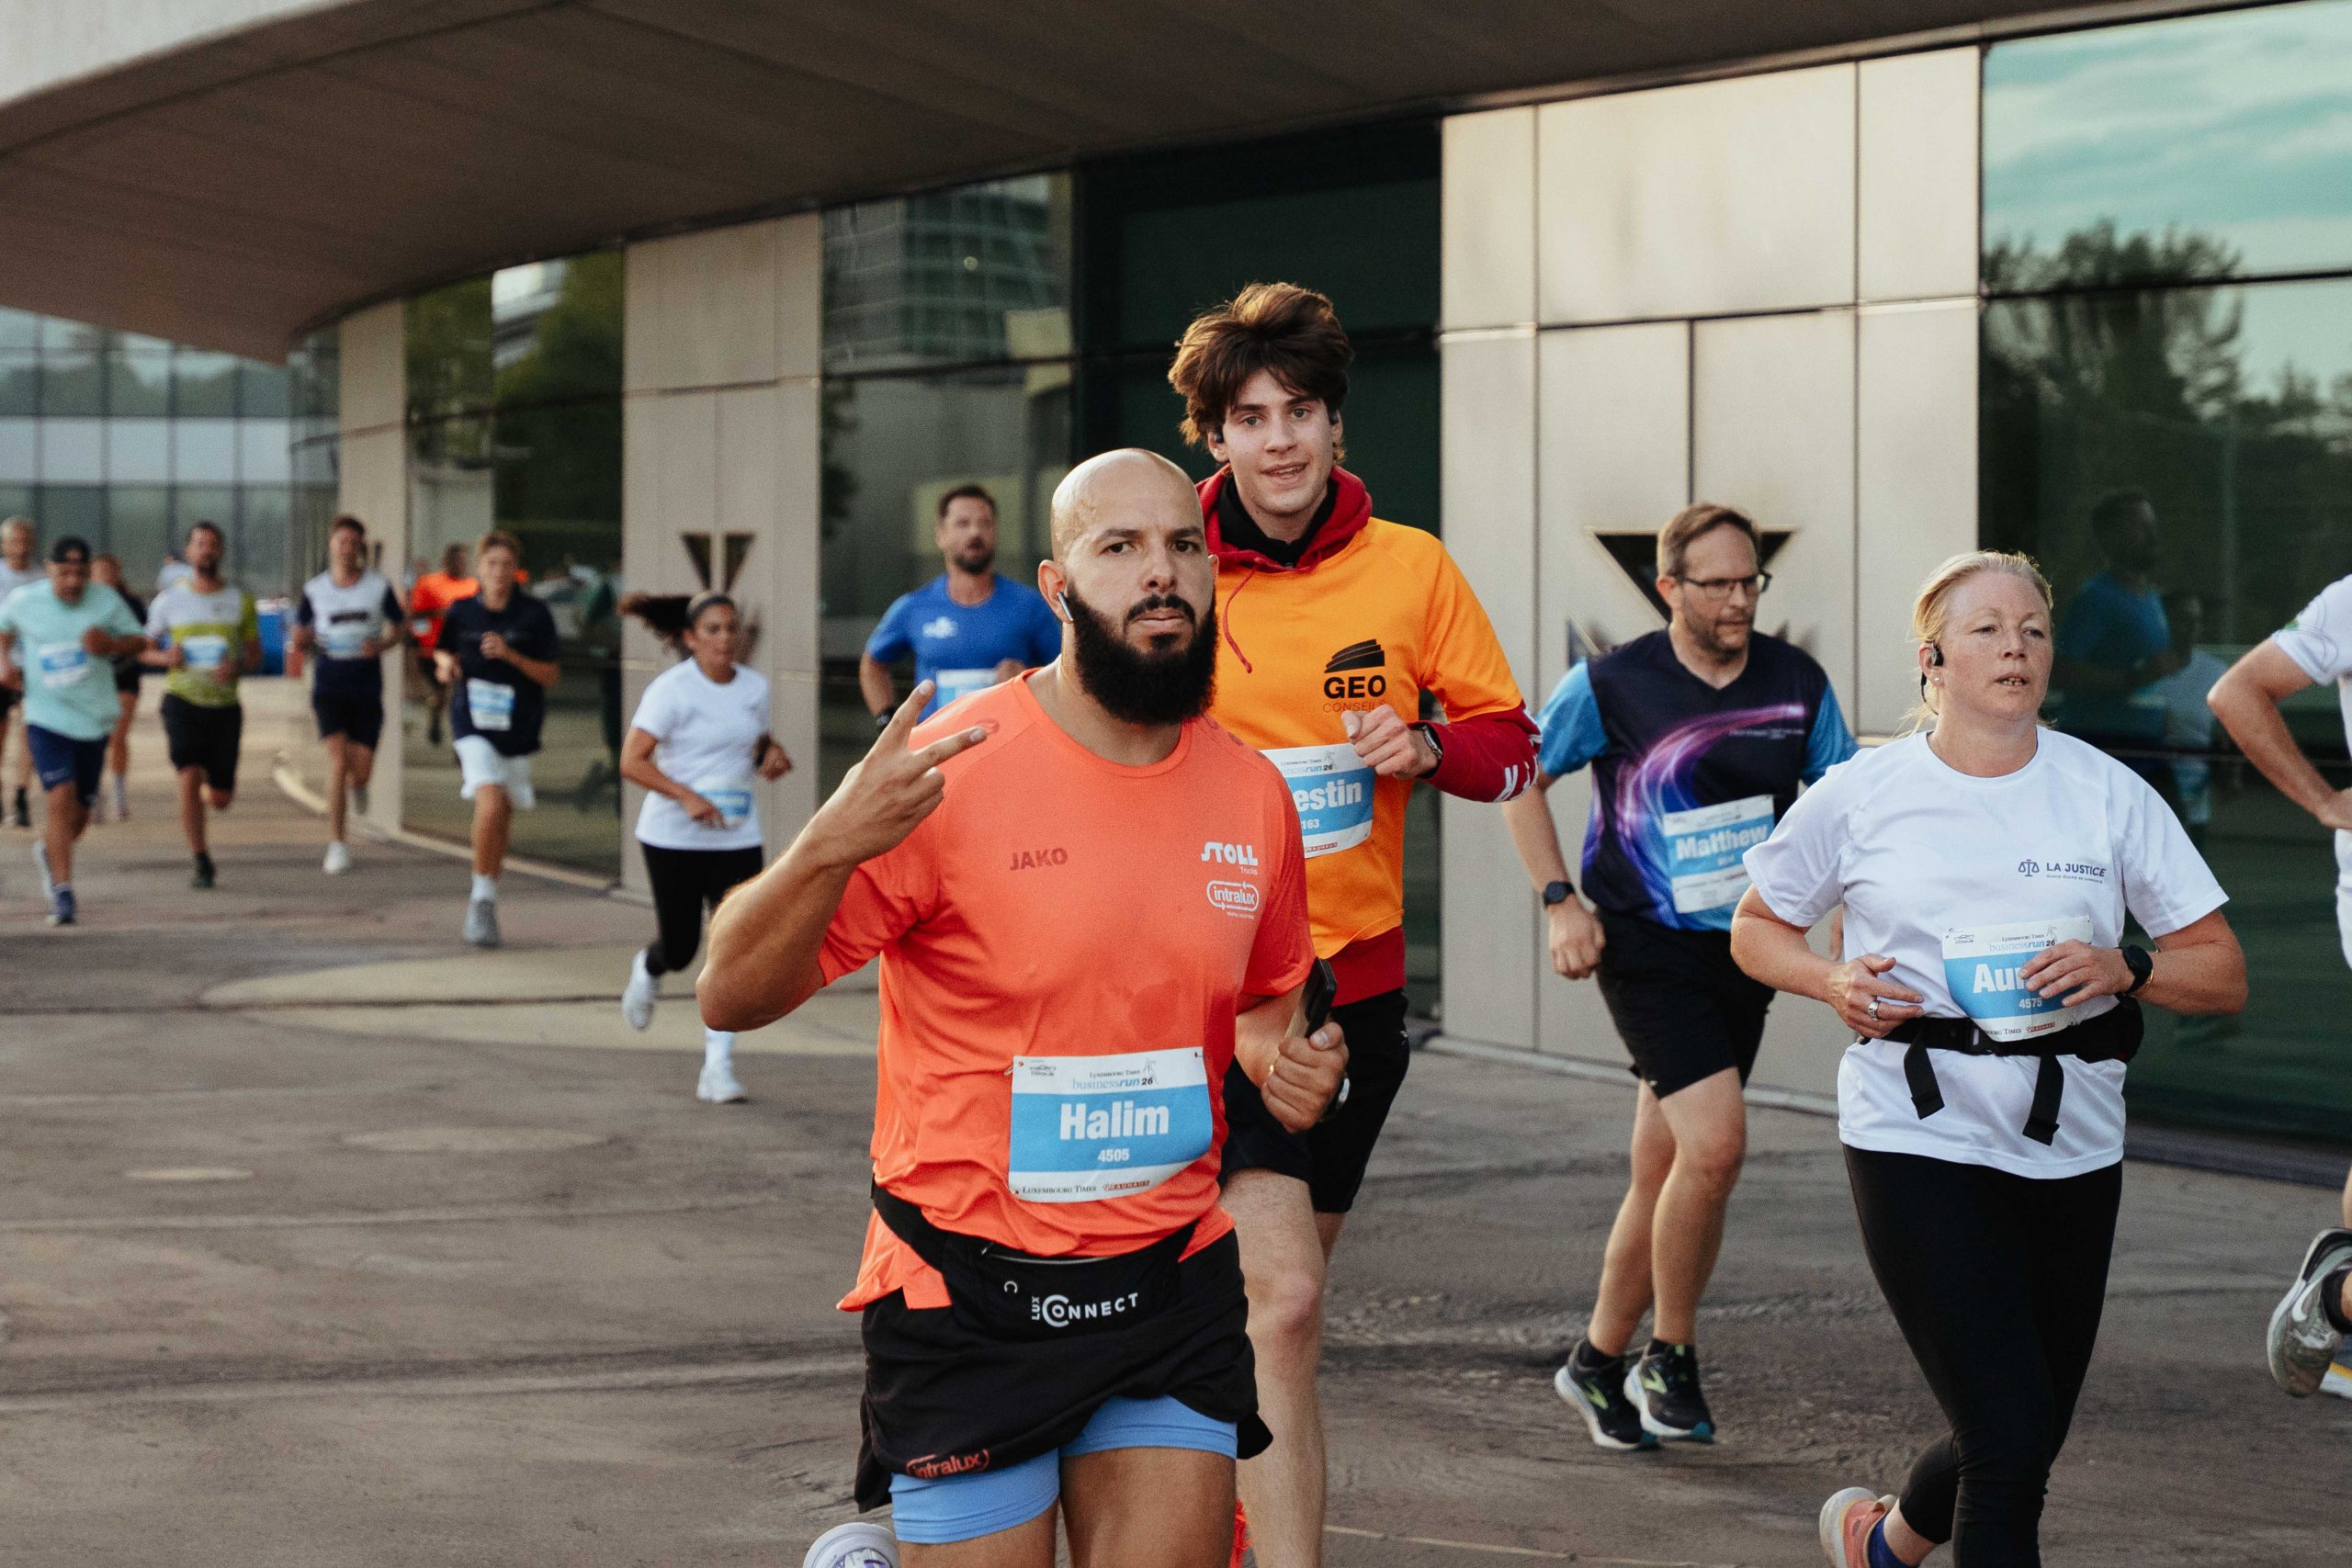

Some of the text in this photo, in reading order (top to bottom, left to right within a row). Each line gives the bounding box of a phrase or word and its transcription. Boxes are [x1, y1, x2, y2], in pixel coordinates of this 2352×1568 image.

[1324, 675, 1386, 699] GEO
[1293, 779, 1363, 813] estin
[1301, 818, 1319, 830] 163
[1010, 848, 1068, 871] JAKO
[1201, 841, 1259, 866] STOLL
[2046, 863, 2107, 877] LA JUSTICE
[1213, 886, 1255, 906] intralux
[2018, 998, 2043, 1010] 4575
[1141, 1077, 1154, 1086] 26
[1059, 1100, 1170, 1140] Halim
[1098, 1148, 1130, 1162] 4505
[1022, 1186, 1073, 1194] LUXEMBOURG
[1031, 1294, 1138, 1328] LUX CONNECT
